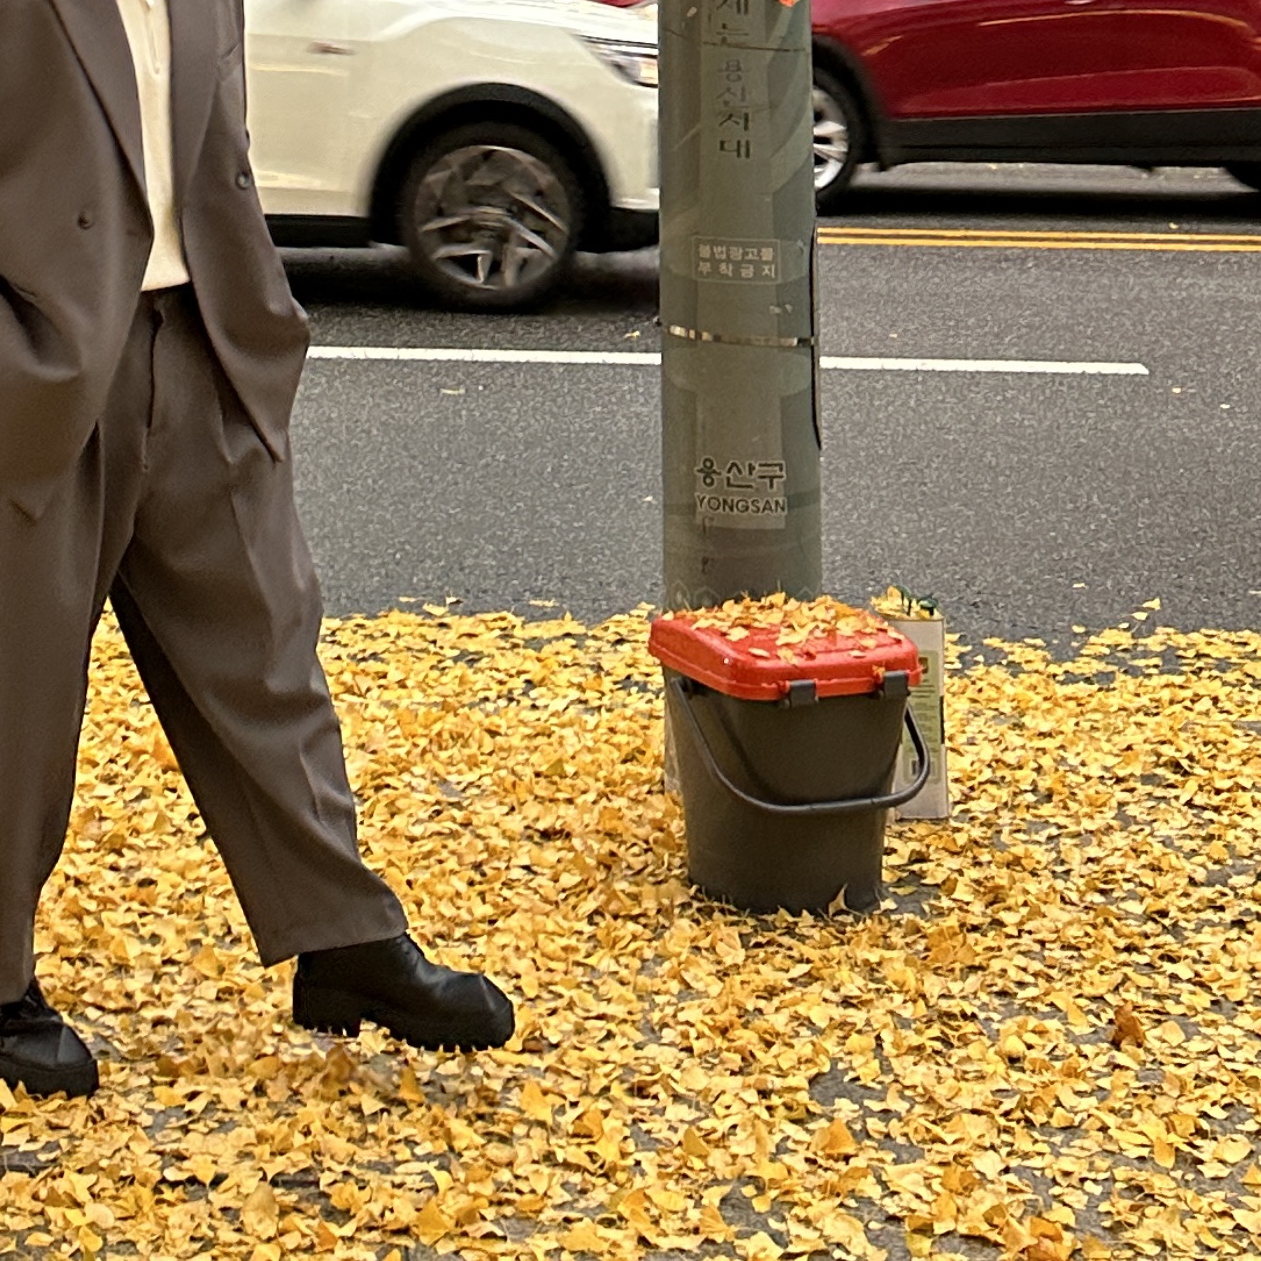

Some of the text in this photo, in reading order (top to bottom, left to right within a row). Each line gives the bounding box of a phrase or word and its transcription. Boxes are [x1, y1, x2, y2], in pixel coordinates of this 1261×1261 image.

[716, 59, 751, 159] 용산시대
[695, 456, 786, 491] 용산구
[695, 493, 788, 513] YONGSAN
